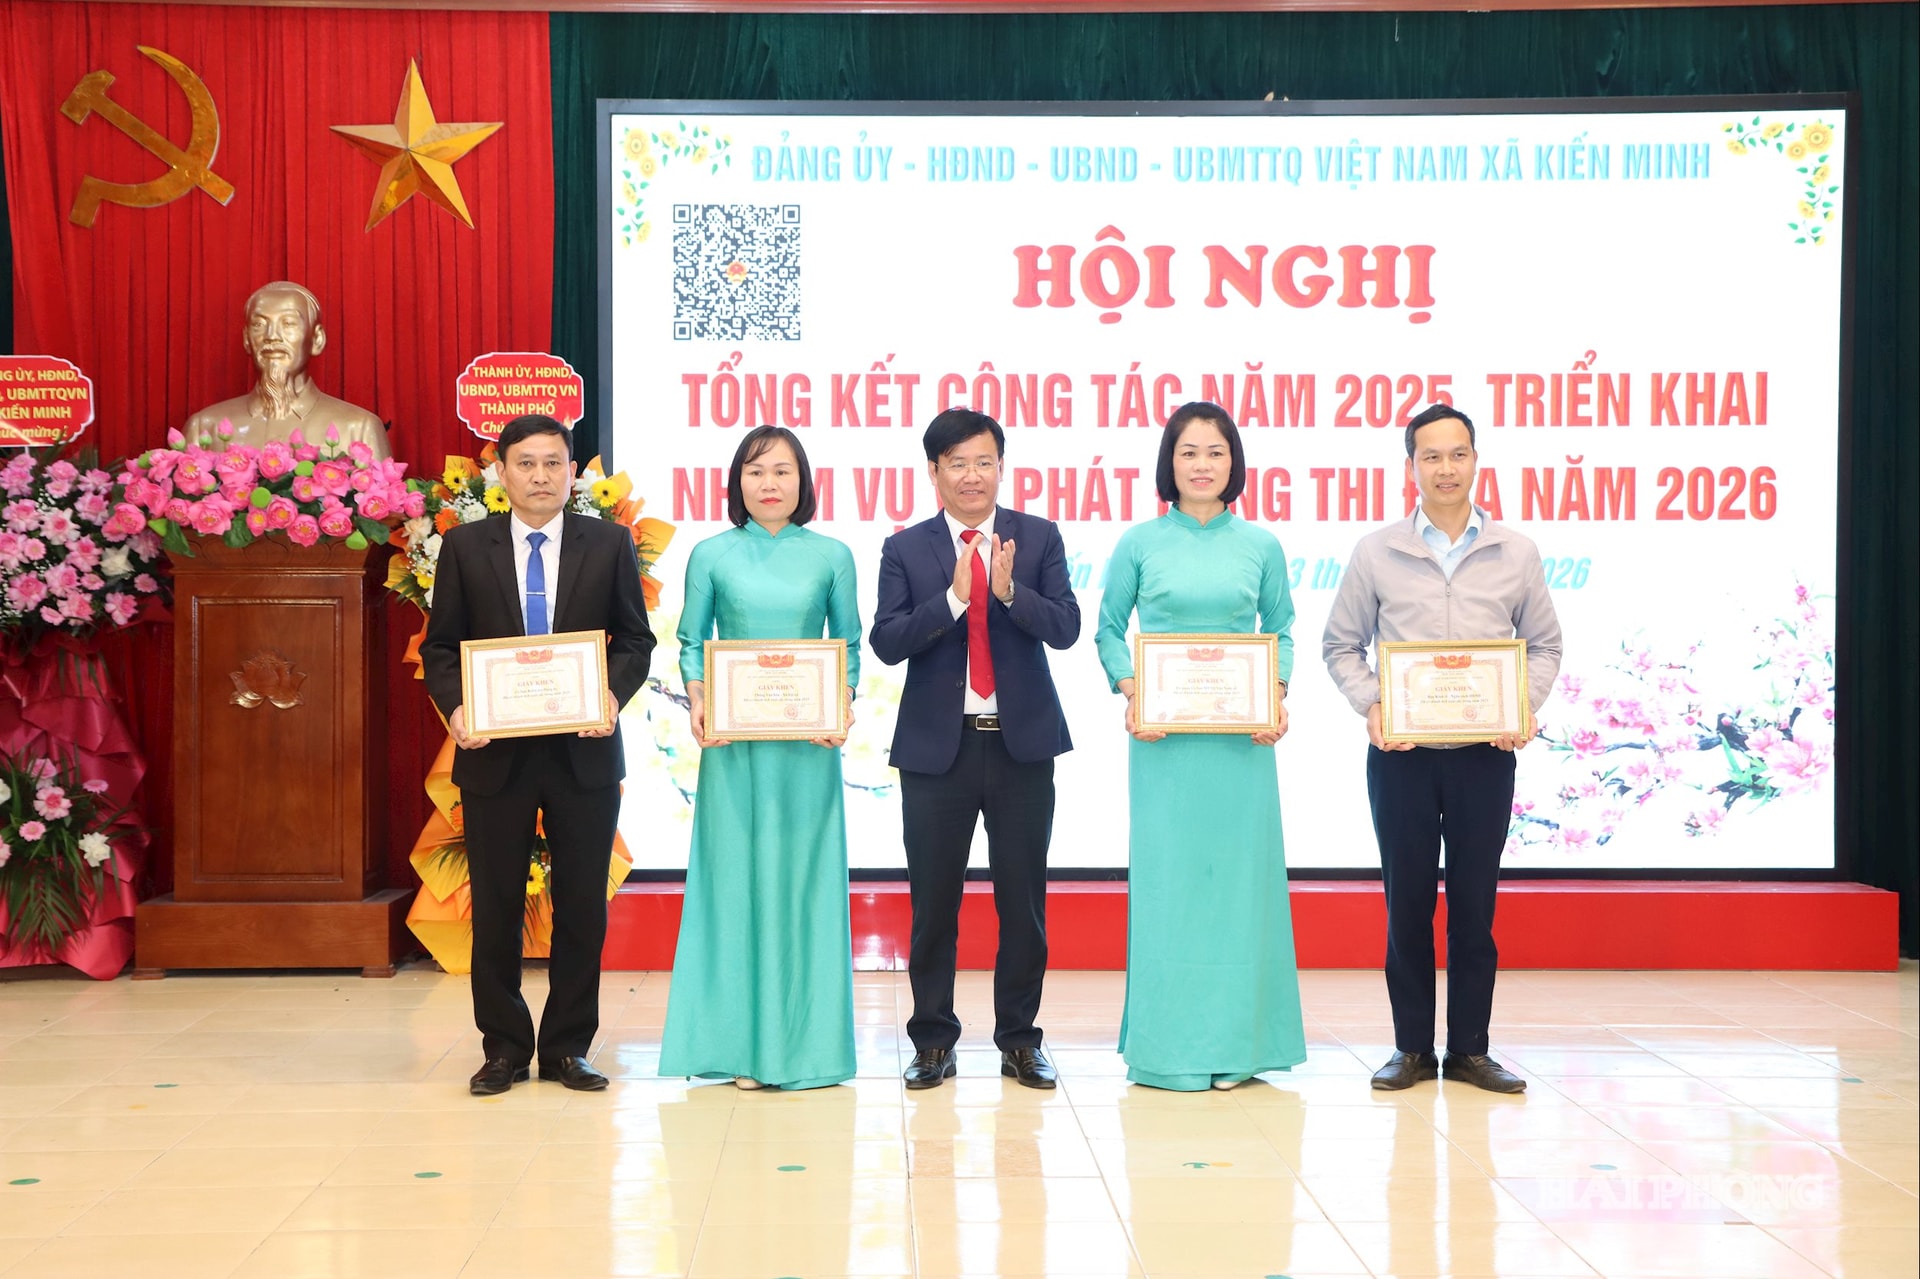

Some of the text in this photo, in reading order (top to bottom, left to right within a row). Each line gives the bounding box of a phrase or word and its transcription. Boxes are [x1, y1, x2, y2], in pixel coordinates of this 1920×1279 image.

[752, 131, 1711, 190] ĐẢNG ỦY - HĐND - UBND - UBMTTQ VIỆT NAM XÃ KIẾN MINH
[1013, 224, 1436, 325] HỘI NGHỊ
[15, 366, 35, 383] ỦY,
[37, 370, 79, 382] HĐND,
[472, 364, 572, 379] THÀNH ỦY, HĐND,
[6, 387, 87, 401] UBMTTQVN
[459, 384, 578, 398] UBND, UBMTTQ VN
[682, 350, 812, 428] TỔNG
[831, 353, 920, 428] KẾT
[937, 361, 1073, 428] CÔNG
[1091, 361, 1183, 428] TÁC
[1202, 361, 1316, 428] NĂM
[1486, 350, 1631, 427] TRIỂN
[1651, 371, 1768, 427] KHAI
[33, 406, 72, 419] MINH
[479, 399, 556, 415] THÀNH PHỐ
[481, 420, 505, 434] Chú
[853, 467, 915, 533] VỤ
[1013, 456, 1140, 521] PHÁT
[1310, 467, 1385, 521] THI
[1521, 455, 1637, 521] NĂM
[1656, 466, 1777, 521] 2026
[1543, 557, 1592, 590] 026
